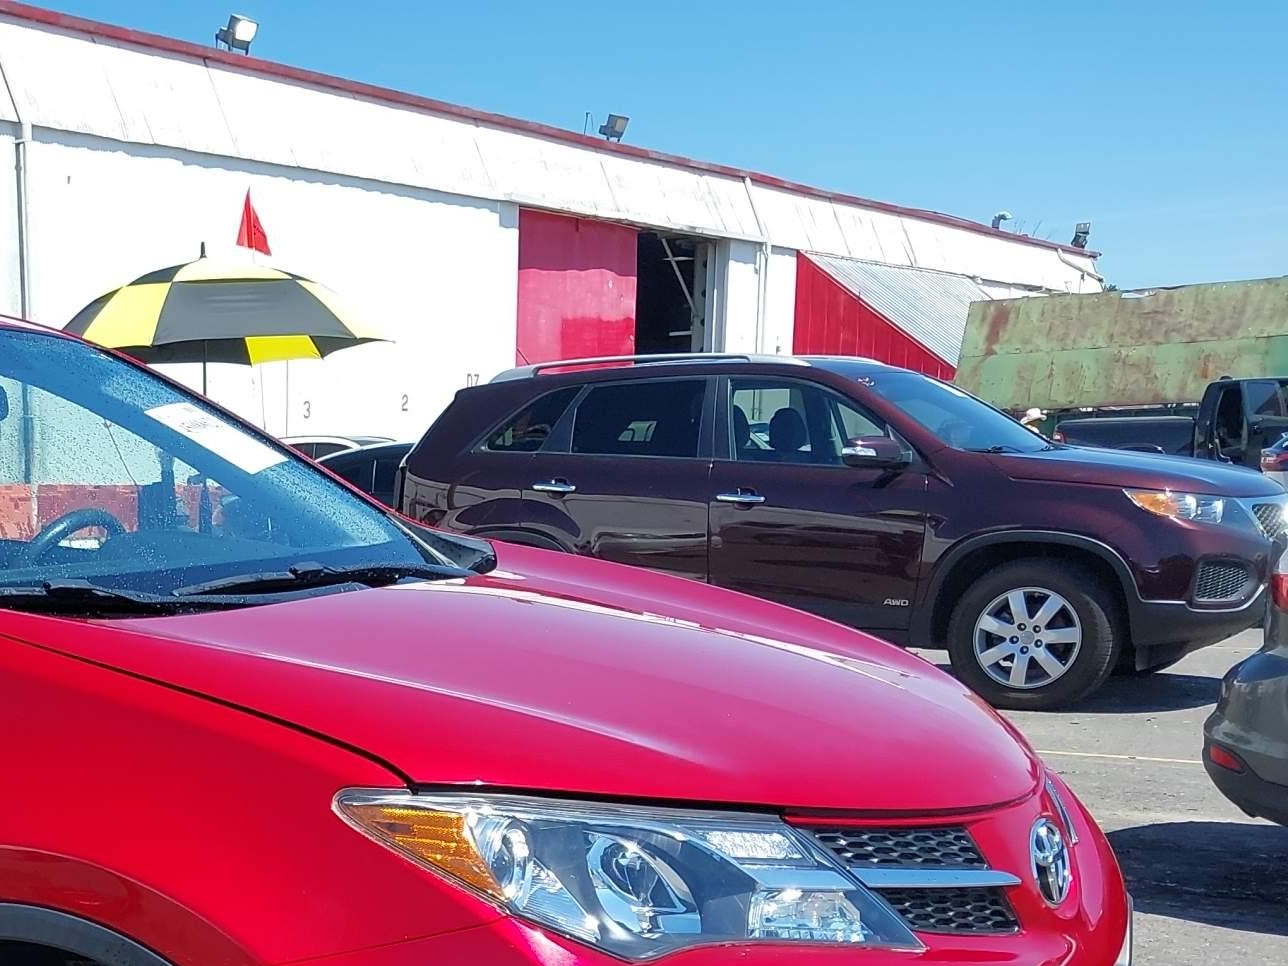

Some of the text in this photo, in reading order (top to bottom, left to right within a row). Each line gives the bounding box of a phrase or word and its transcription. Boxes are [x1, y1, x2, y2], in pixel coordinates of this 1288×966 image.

[303, 400, 311, 419] 3
[401, 393, 409, 412] 2
[883, 598, 910, 606] AWD
